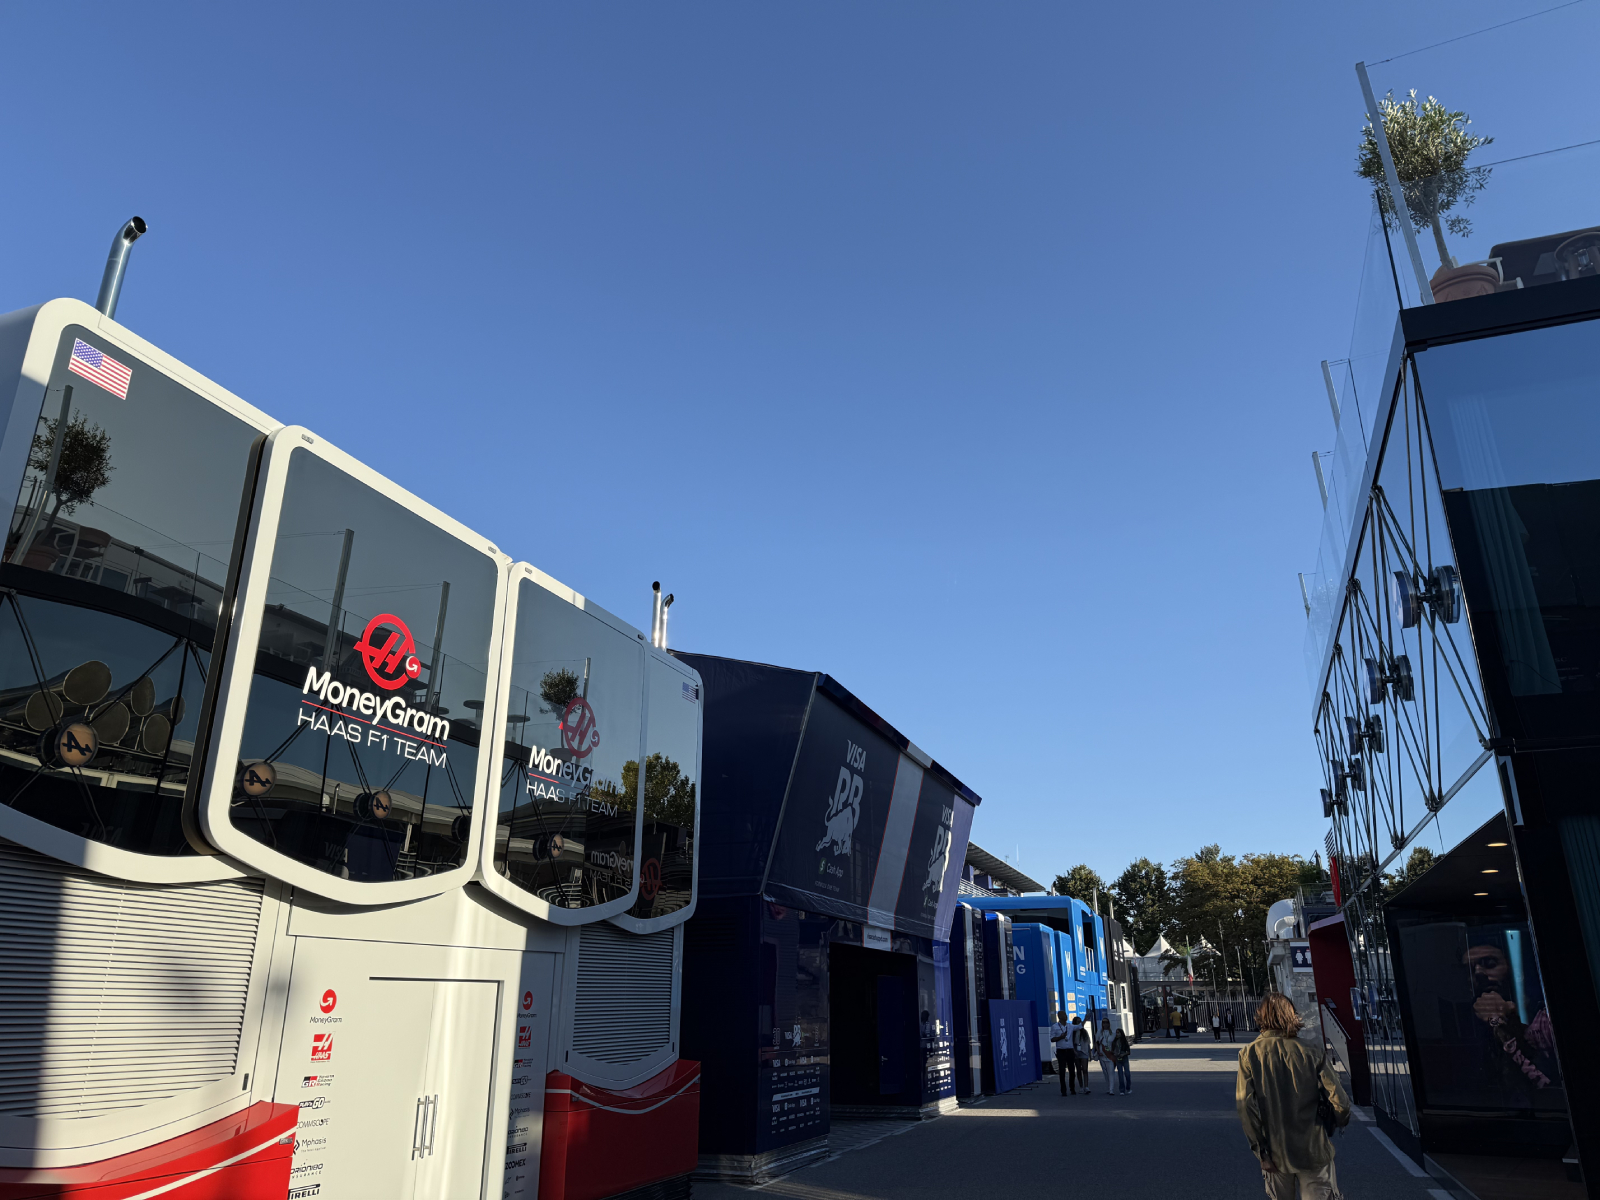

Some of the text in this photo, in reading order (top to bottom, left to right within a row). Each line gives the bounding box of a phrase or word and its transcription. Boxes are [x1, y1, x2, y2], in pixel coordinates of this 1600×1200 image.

[302, 665, 450, 741] MoneyGram
[297, 708, 447, 769] HAAS F1 TEAM
[846, 739, 867, 772] VISA
[528, 745, 617, 795] MoneyGam
[526, 779, 618, 818] HAAS F1 TEAM
[309, 1016, 343, 1025] MoneyGram
[302, 1137, 327, 1148] Mphasis
